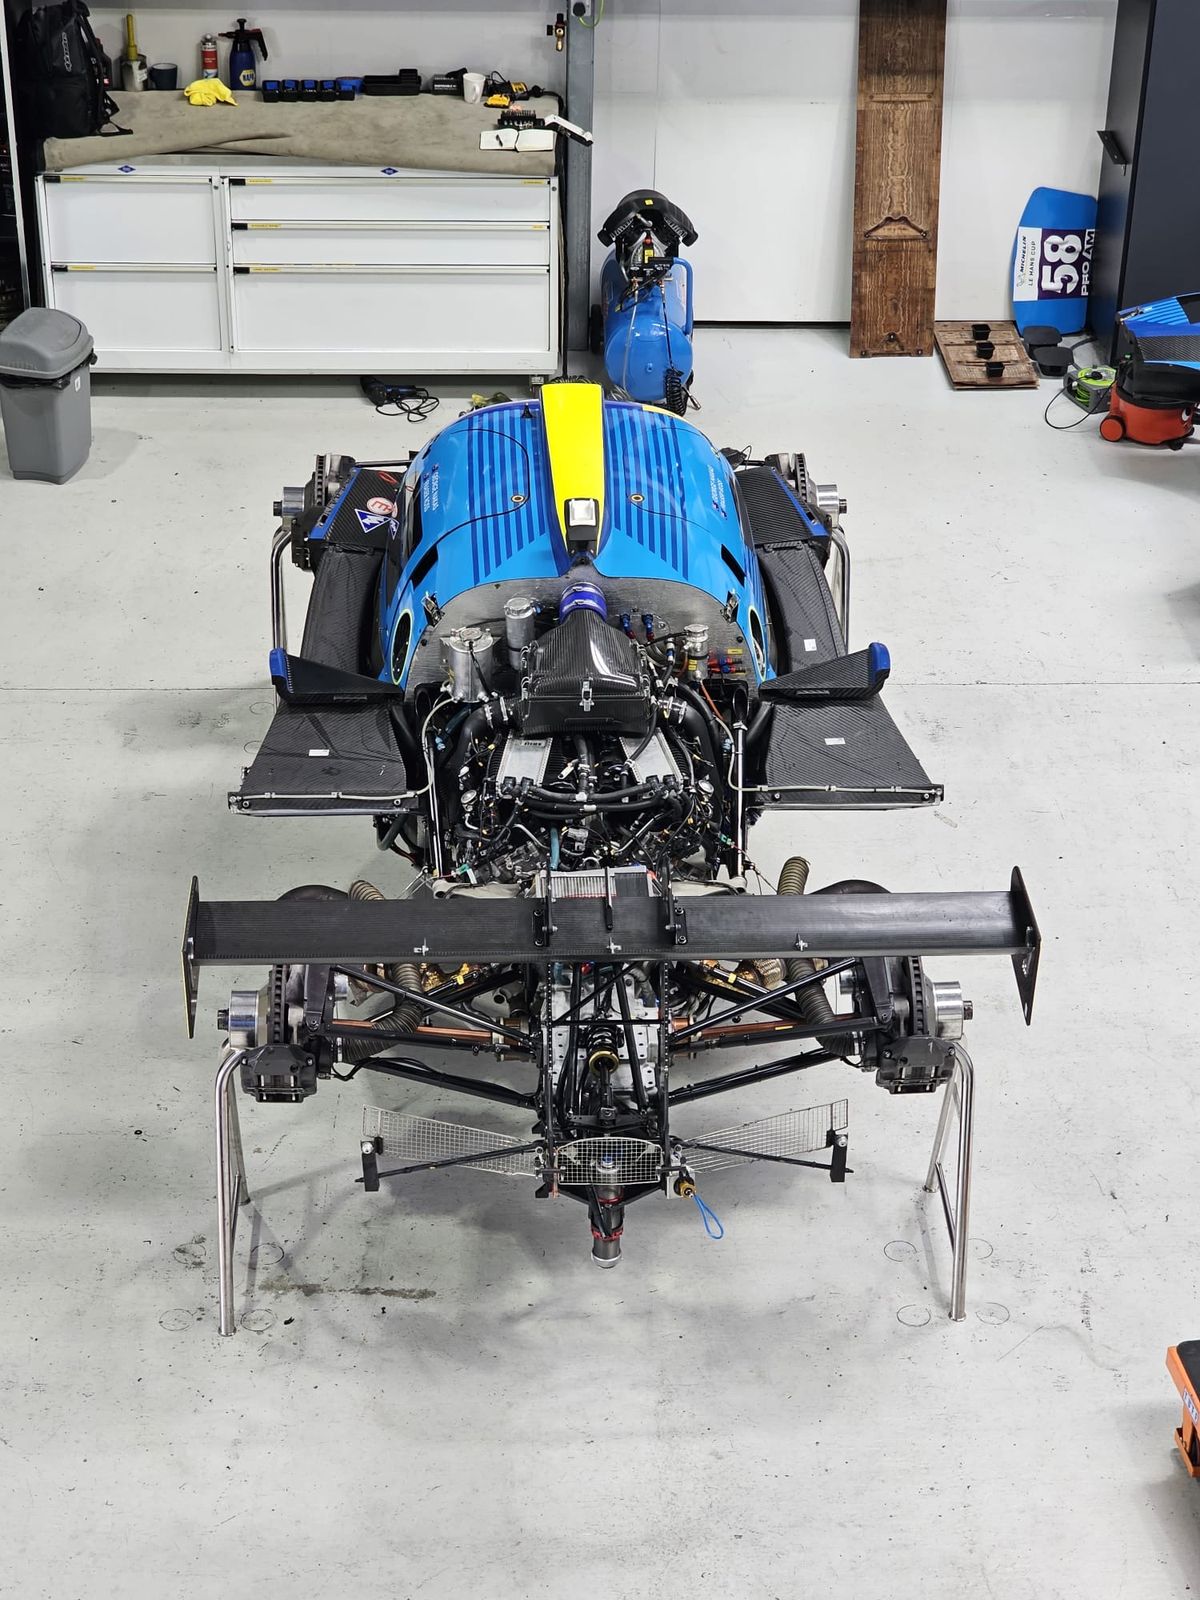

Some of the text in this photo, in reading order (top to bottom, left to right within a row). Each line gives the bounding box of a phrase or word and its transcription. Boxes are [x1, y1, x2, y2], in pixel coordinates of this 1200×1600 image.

[1042, 235, 1082, 294] 58
[1081, 262, 1090, 296] PRO
[1028, 278, 1033, 286] LE
